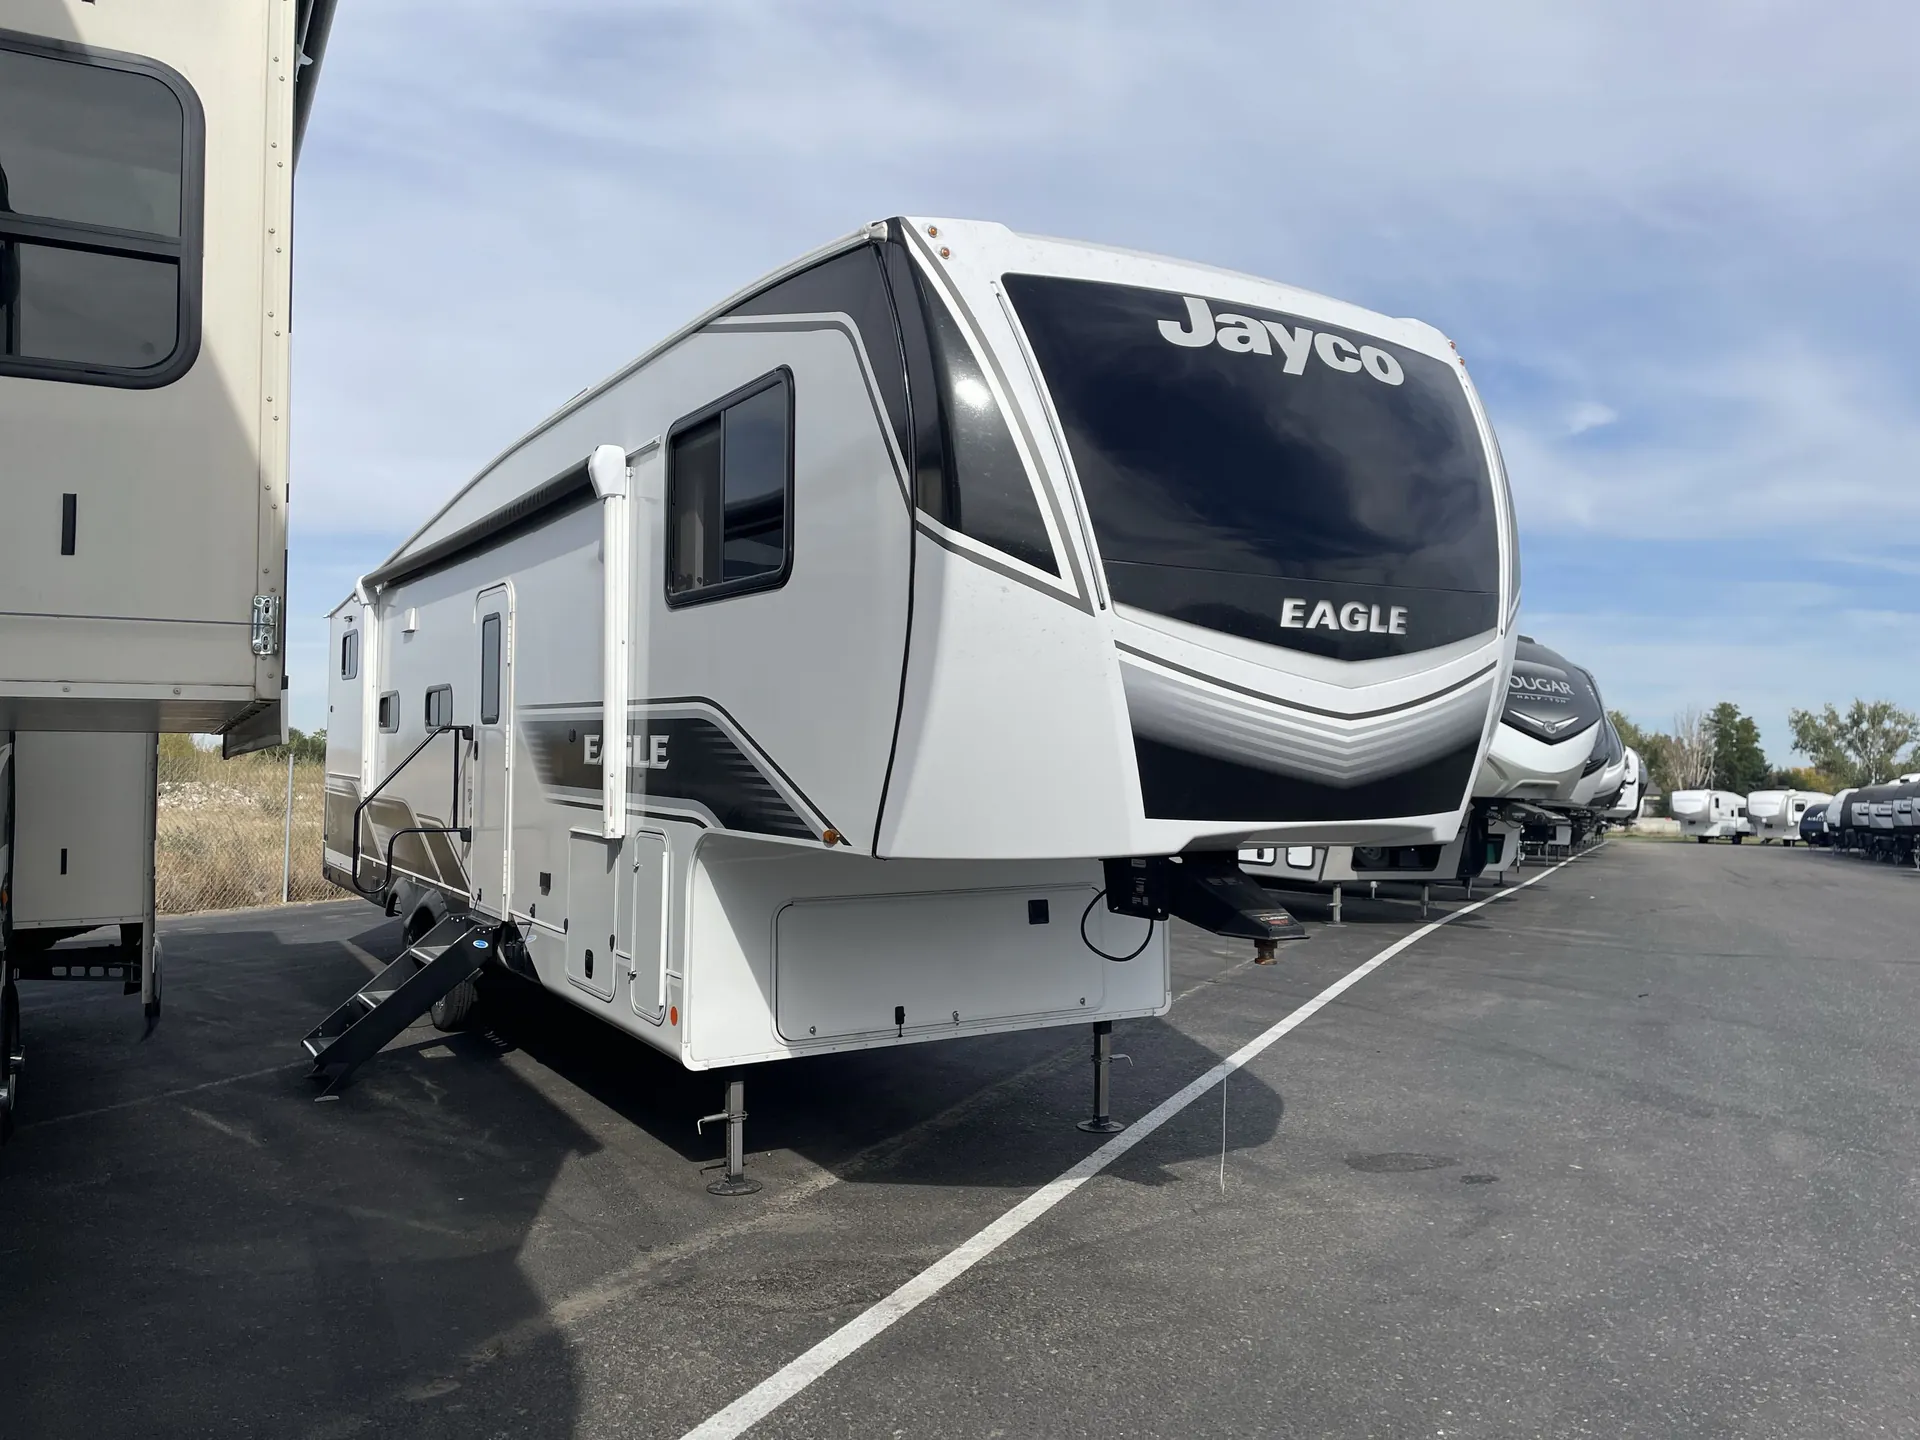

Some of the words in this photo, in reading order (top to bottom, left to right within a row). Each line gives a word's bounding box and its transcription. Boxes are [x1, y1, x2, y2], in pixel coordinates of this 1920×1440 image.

[1157, 296, 1405, 386] Jayco
[1280, 598, 1408, 635] EAGLE
[1509, 675, 1575, 695] OUGAR
[583, 734, 670, 769] ELE
